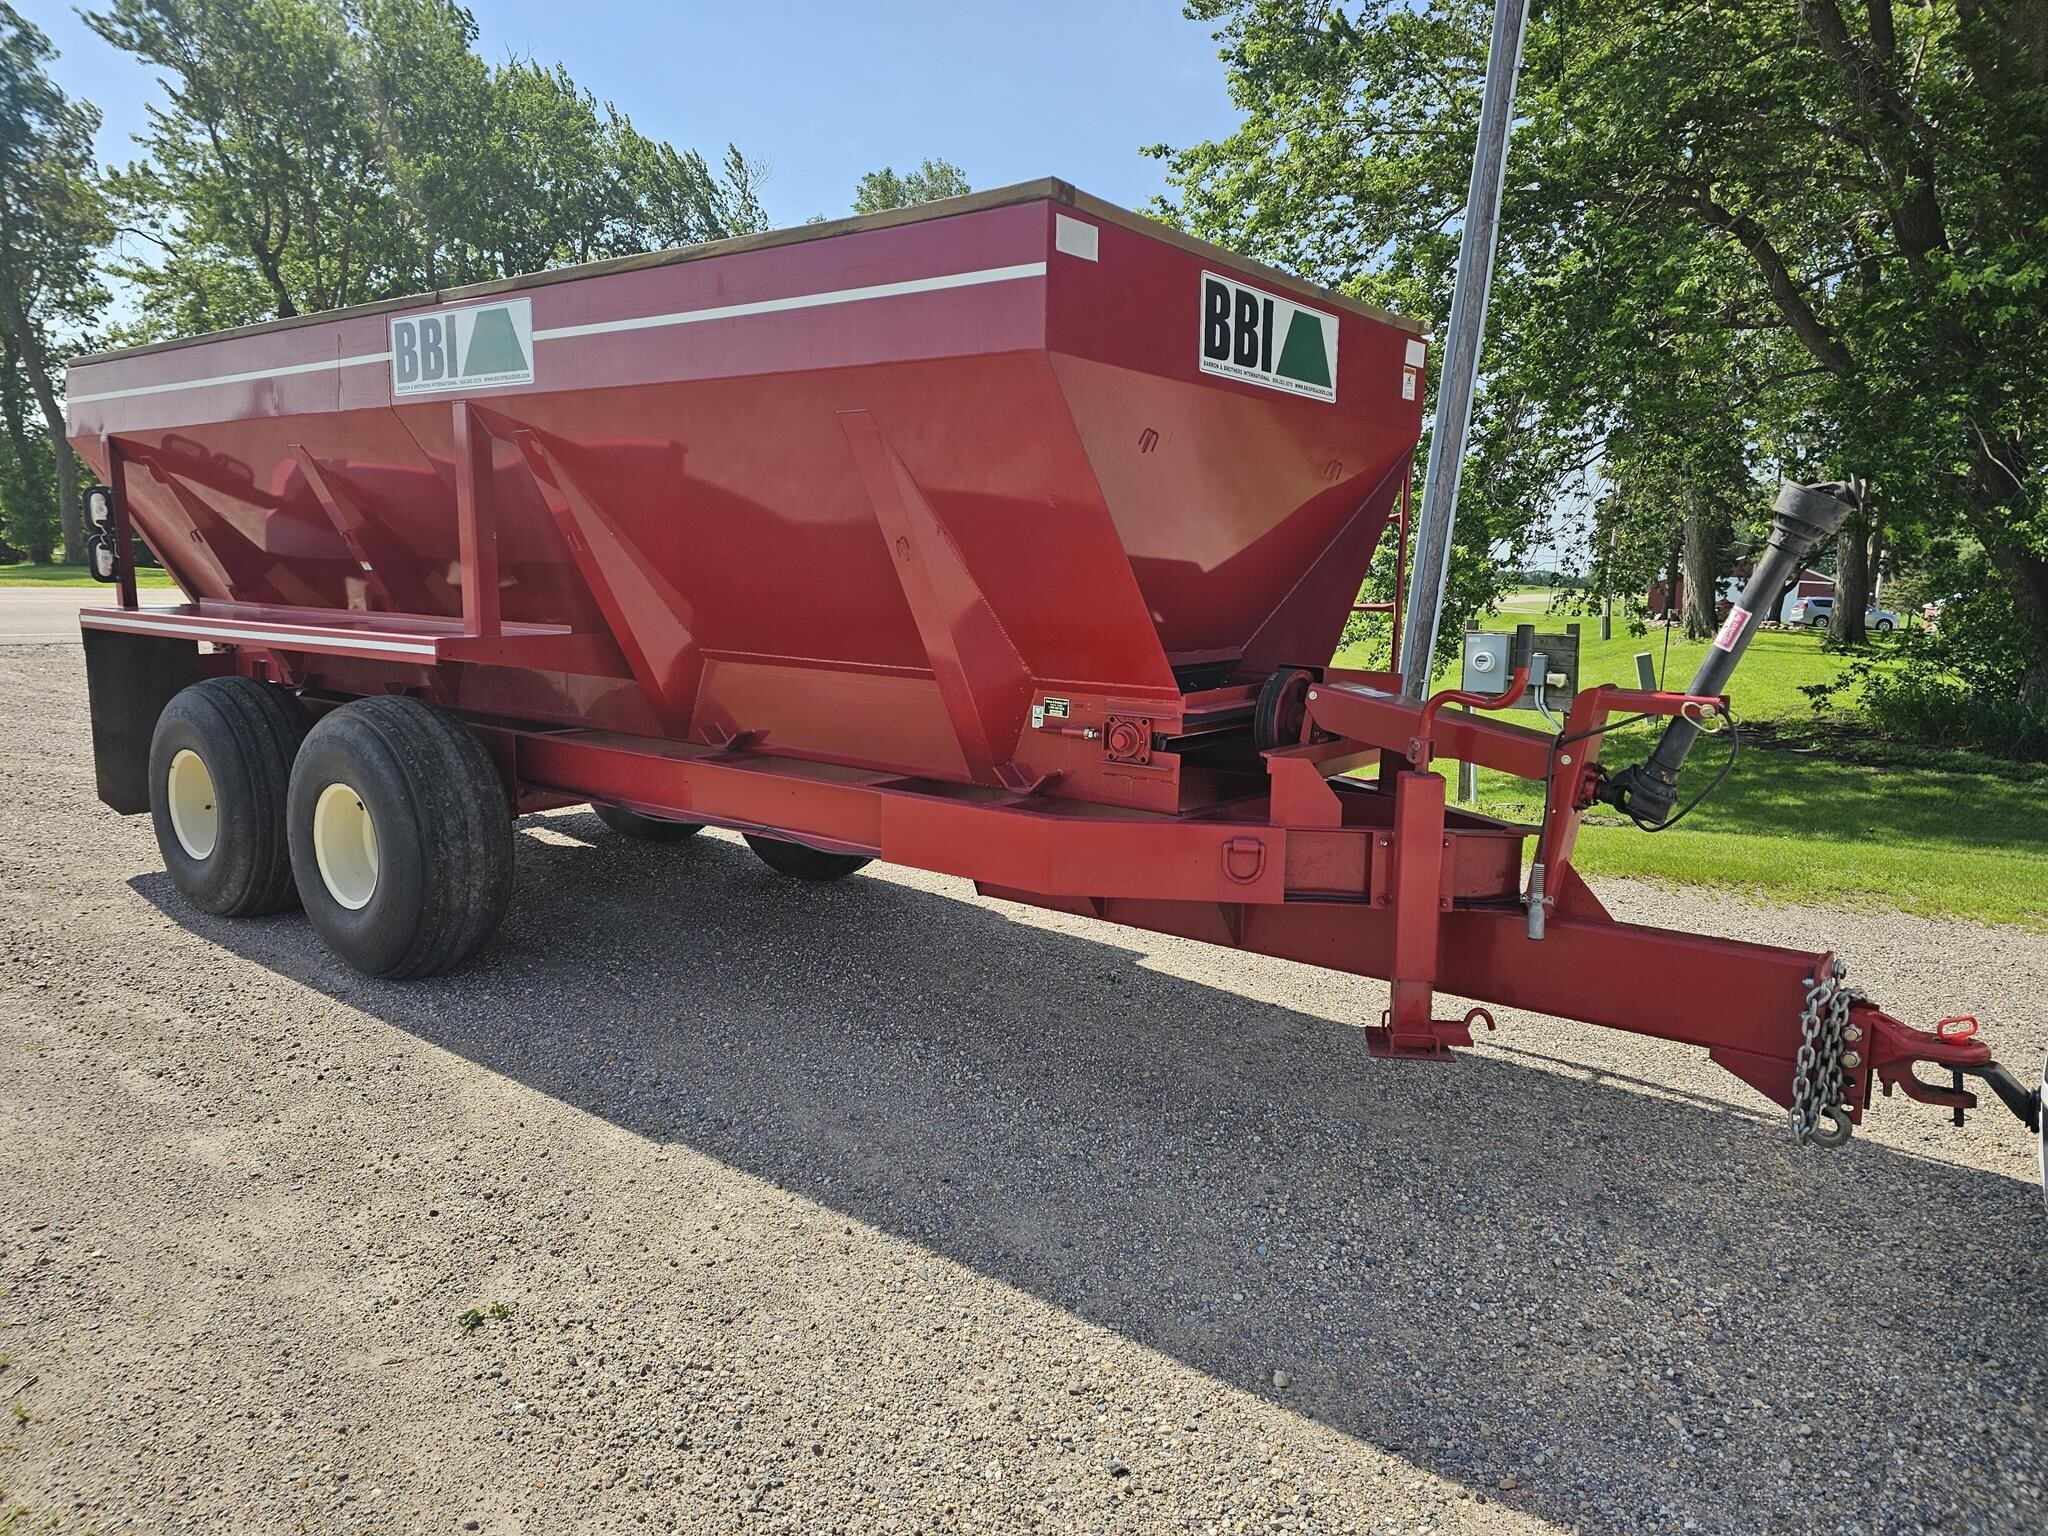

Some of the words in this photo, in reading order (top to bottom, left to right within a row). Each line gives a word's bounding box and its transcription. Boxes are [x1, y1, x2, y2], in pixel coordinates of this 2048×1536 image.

[394, 315, 458, 384] BBI
[1204, 278, 1274, 373] BBI
[1203, 360, 1219, 369] BARRON
[1223, 365, 1243, 375] BROTHERS
[1243, 370, 1270, 382] INTERNATIONAL
